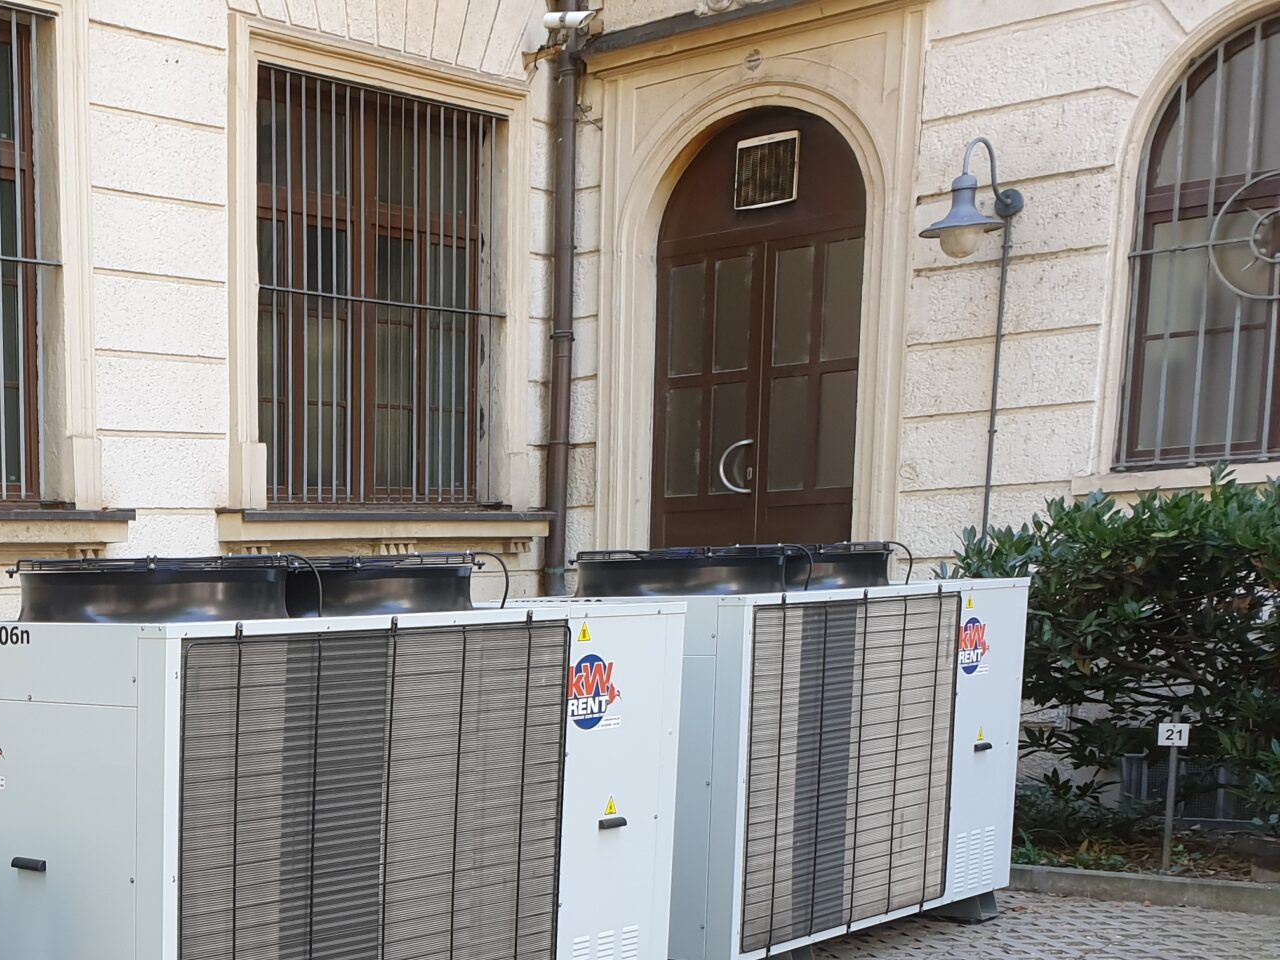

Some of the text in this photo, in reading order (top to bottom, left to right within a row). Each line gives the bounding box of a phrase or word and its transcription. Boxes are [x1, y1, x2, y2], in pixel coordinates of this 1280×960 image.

[959, 649, 983, 664] RENT
[567, 696, 609, 717] RENT
[1165, 728, 1183, 741] 21
